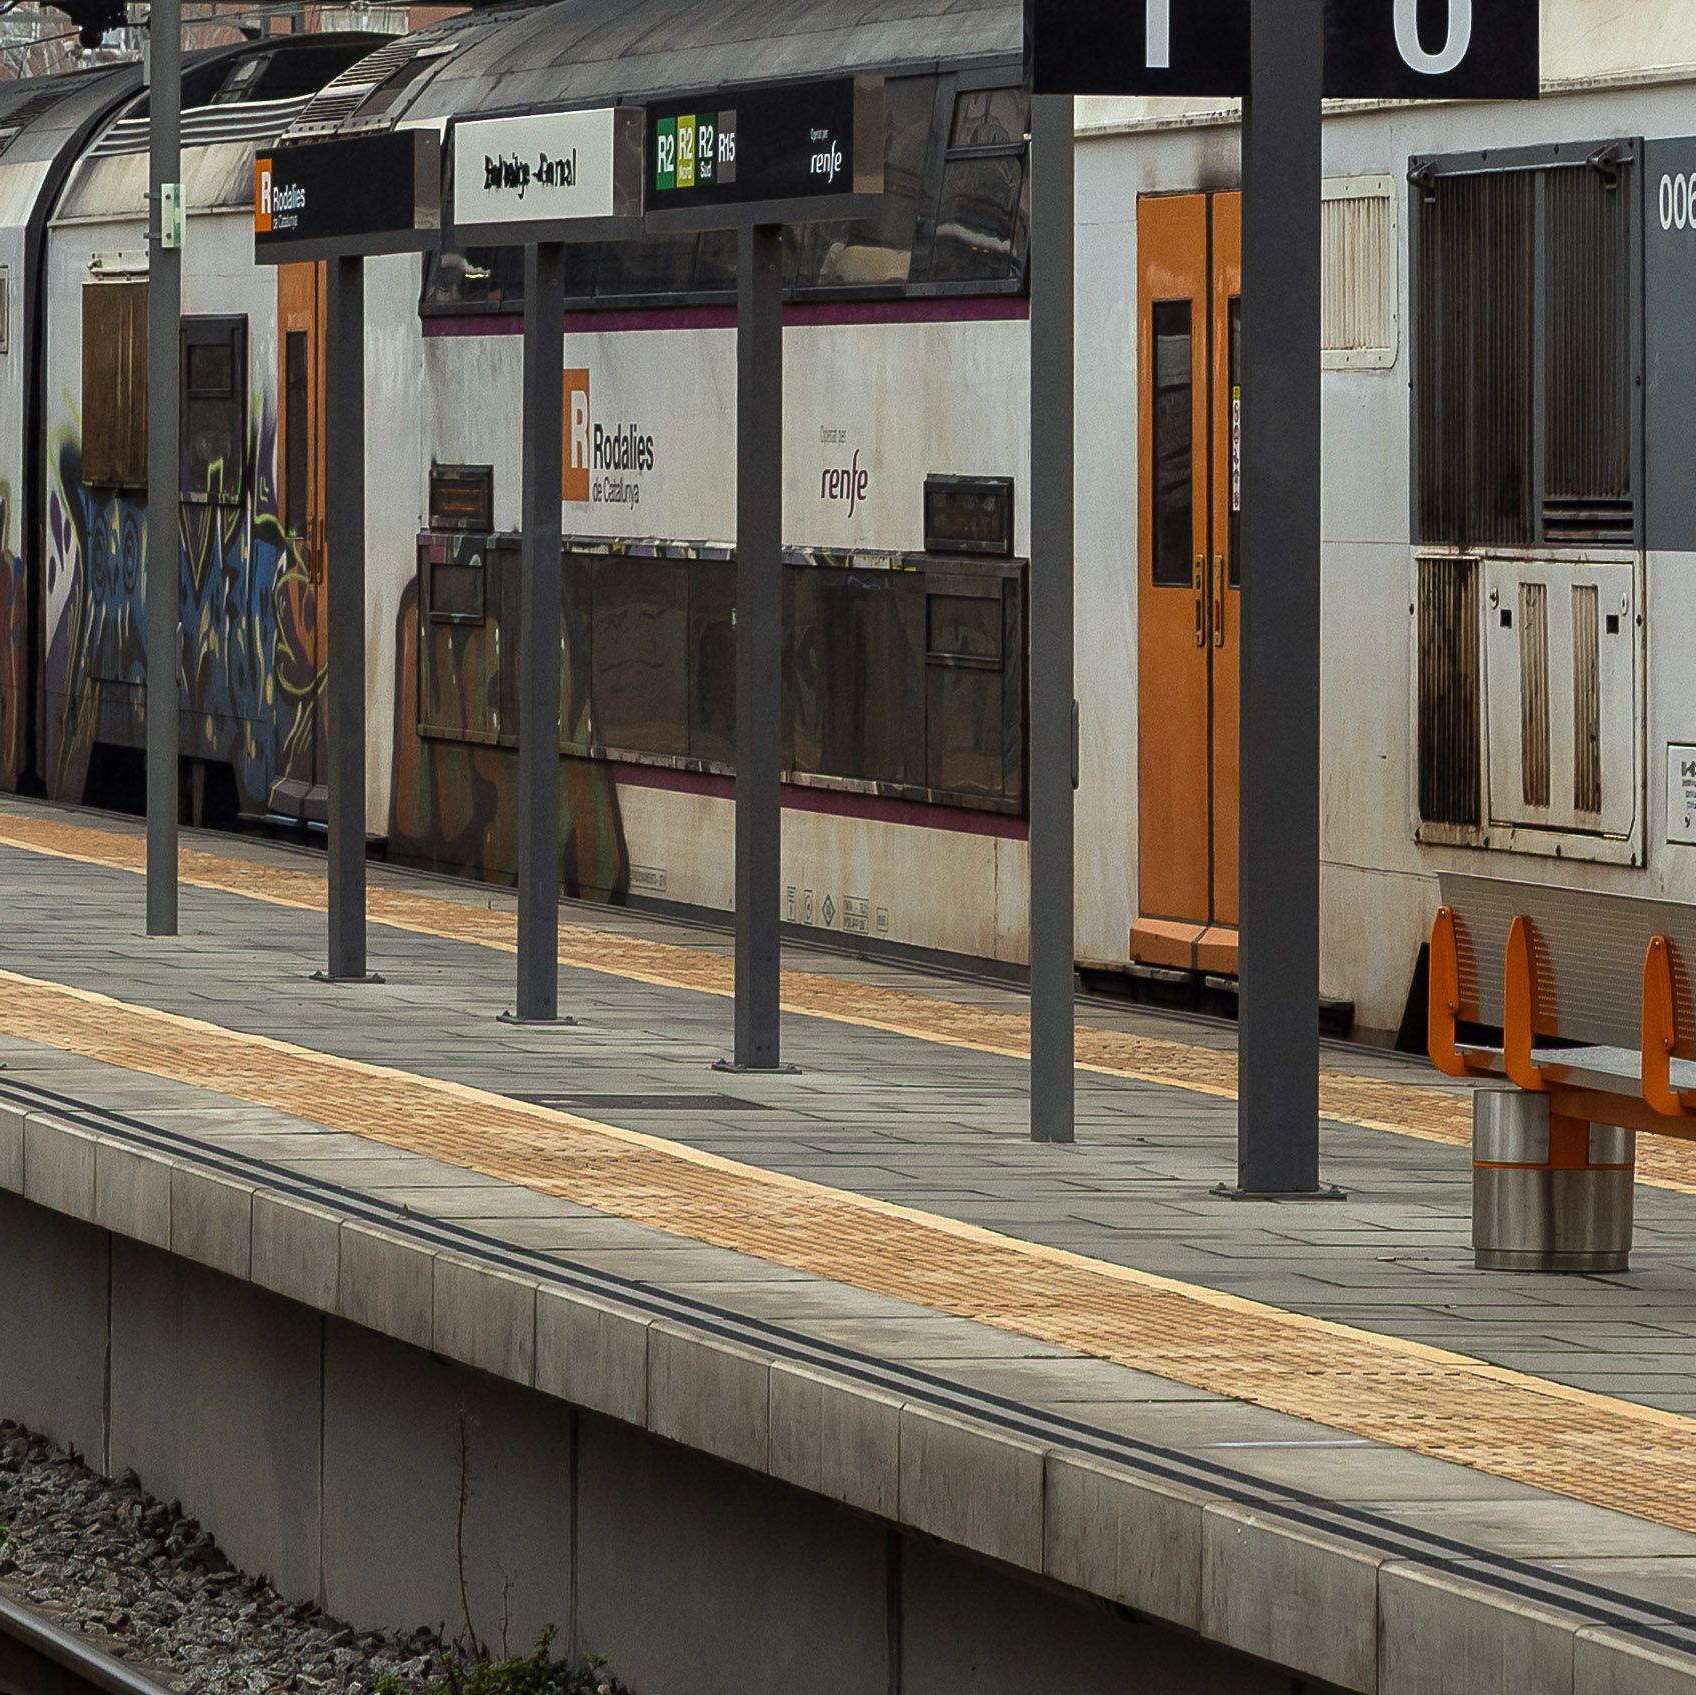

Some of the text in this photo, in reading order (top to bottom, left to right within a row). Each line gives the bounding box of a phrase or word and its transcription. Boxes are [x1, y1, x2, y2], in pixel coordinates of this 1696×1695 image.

[658, 134, 675, 173] R2
[678, 127, 693, 161] R2
[699, 125, 714, 158] R2
[718, 132, 736, 163] R15
[810, 140, 842, 184] renfe
[261, 171, 271, 214] R
[273, 184, 305, 211] Rodalies
[571, 390, 589, 469] R
[594, 423, 654, 471] Rodalies
[593, 476, 639, 510] de Catalunya
[821, 449, 868, 518] renfe
